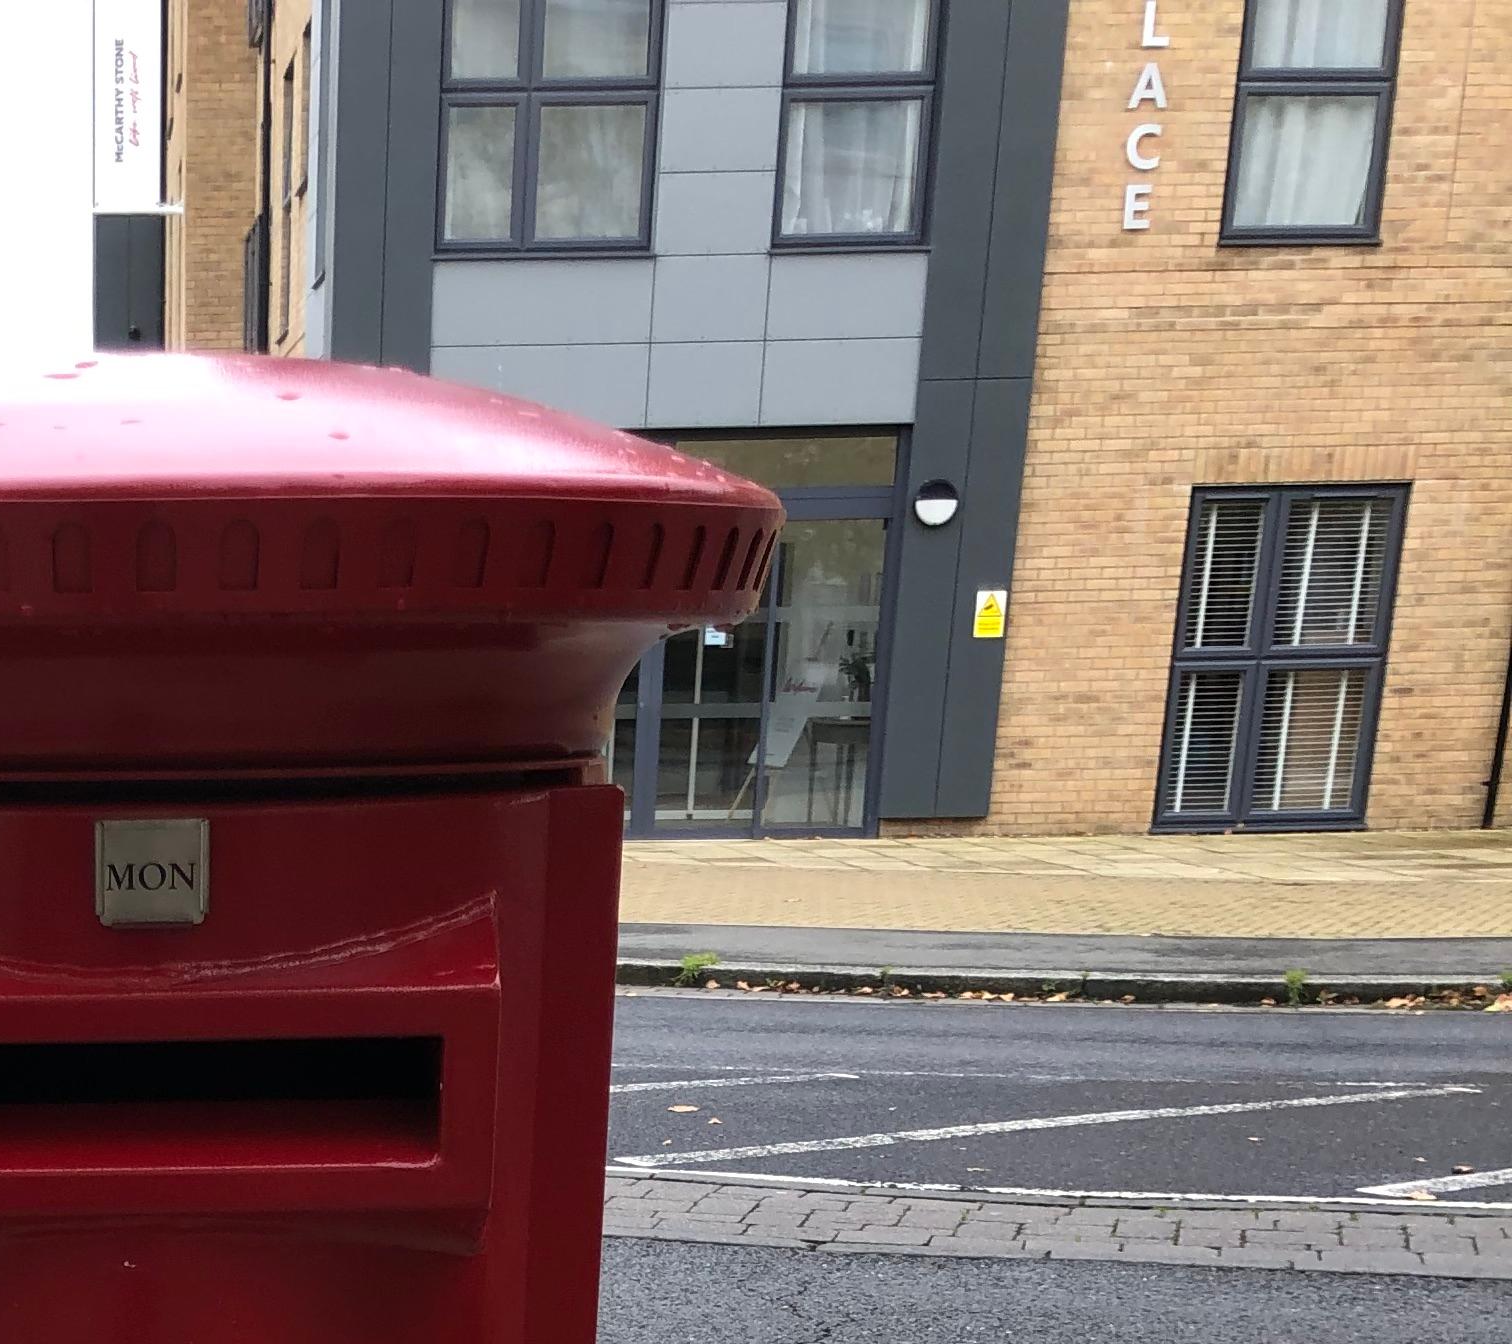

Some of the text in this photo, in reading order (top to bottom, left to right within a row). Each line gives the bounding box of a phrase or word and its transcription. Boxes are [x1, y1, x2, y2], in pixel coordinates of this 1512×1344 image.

[114, 39, 125, 163] McCARTHY STONE
[106, 862, 197, 892] MON
